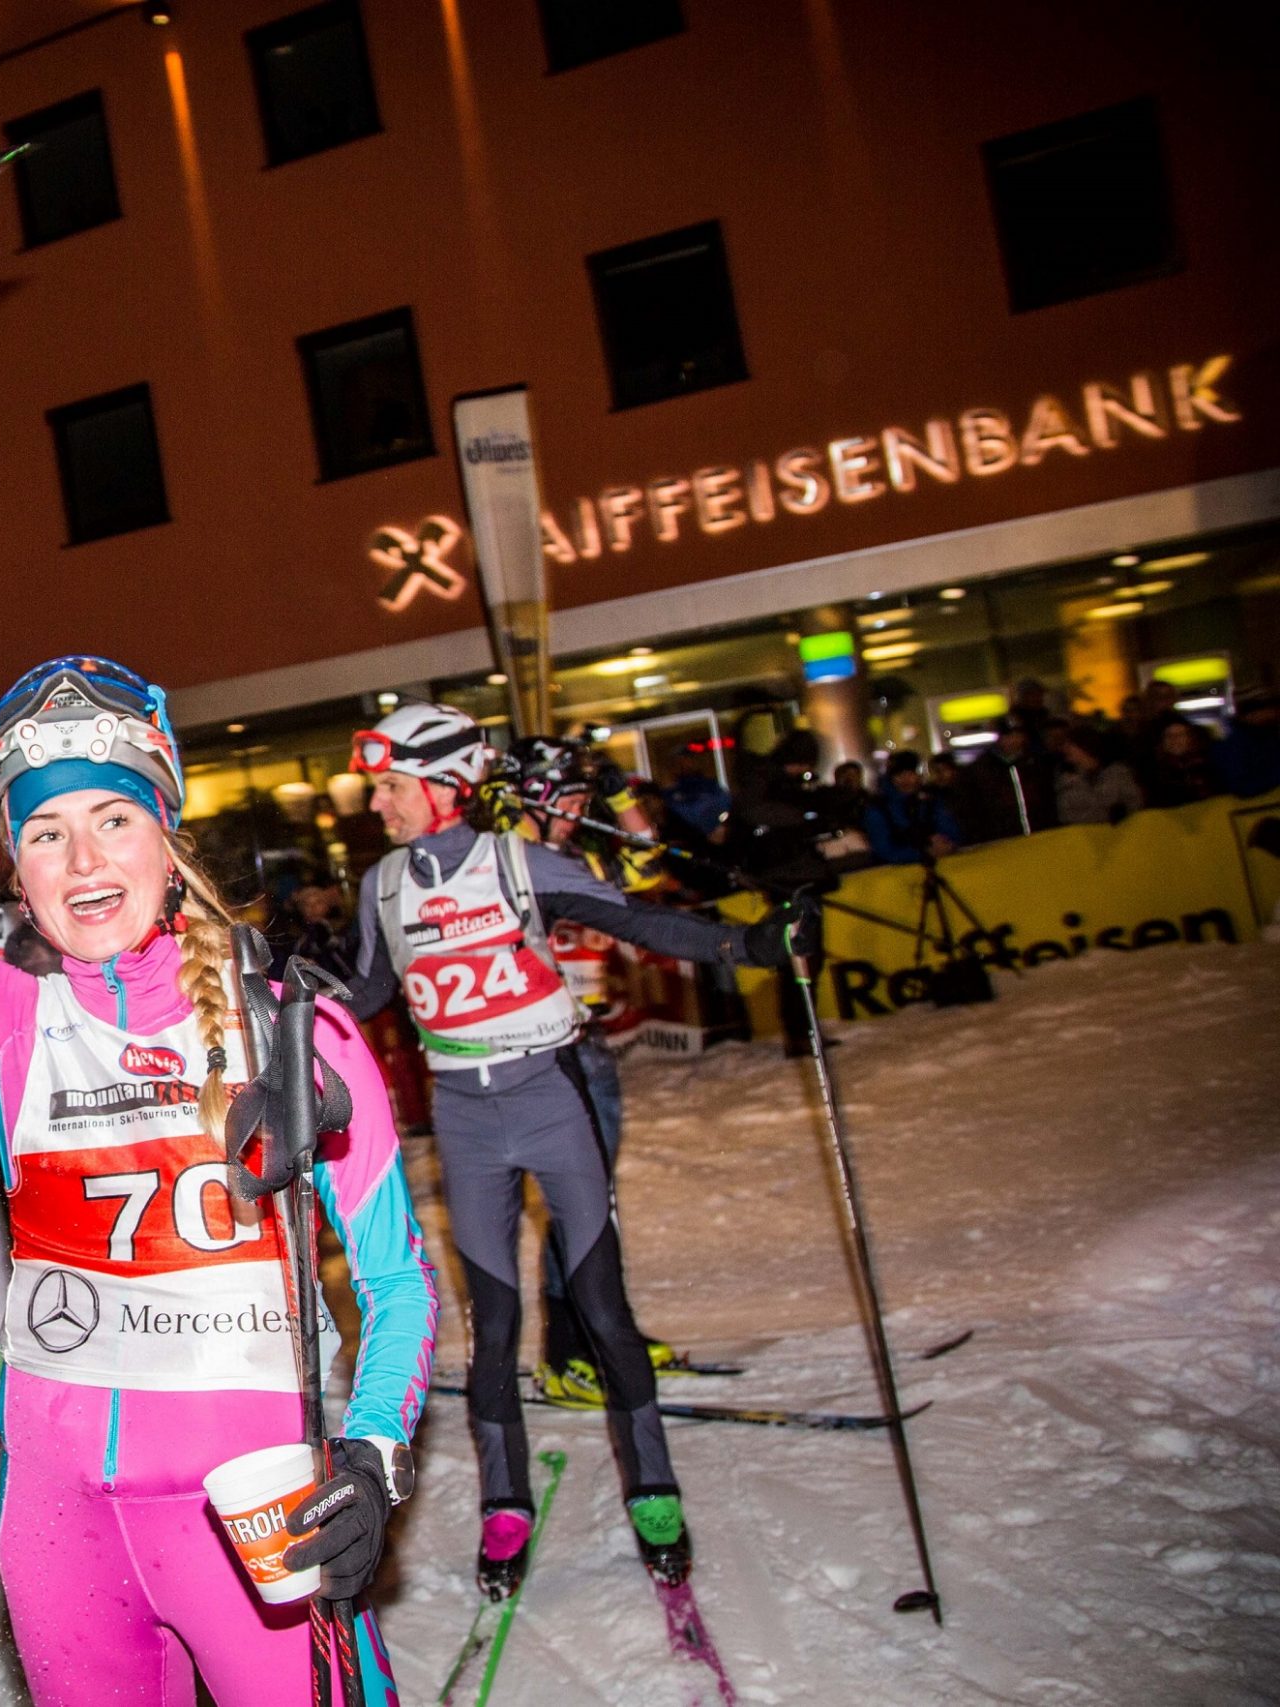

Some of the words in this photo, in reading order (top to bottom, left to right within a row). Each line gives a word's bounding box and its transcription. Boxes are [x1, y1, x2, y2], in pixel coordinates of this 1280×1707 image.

[539, 354, 1242, 565] AIFFEISENBANK
[442, 910, 503, 939] attack
[404, 951, 530, 1021] 924
[65, 1082, 155, 1109] mountain
[47, 1117, 115, 1133] International
[119, 1110, 177, 1127] Ski-Touring
[82, 1160, 264, 1263] 70
